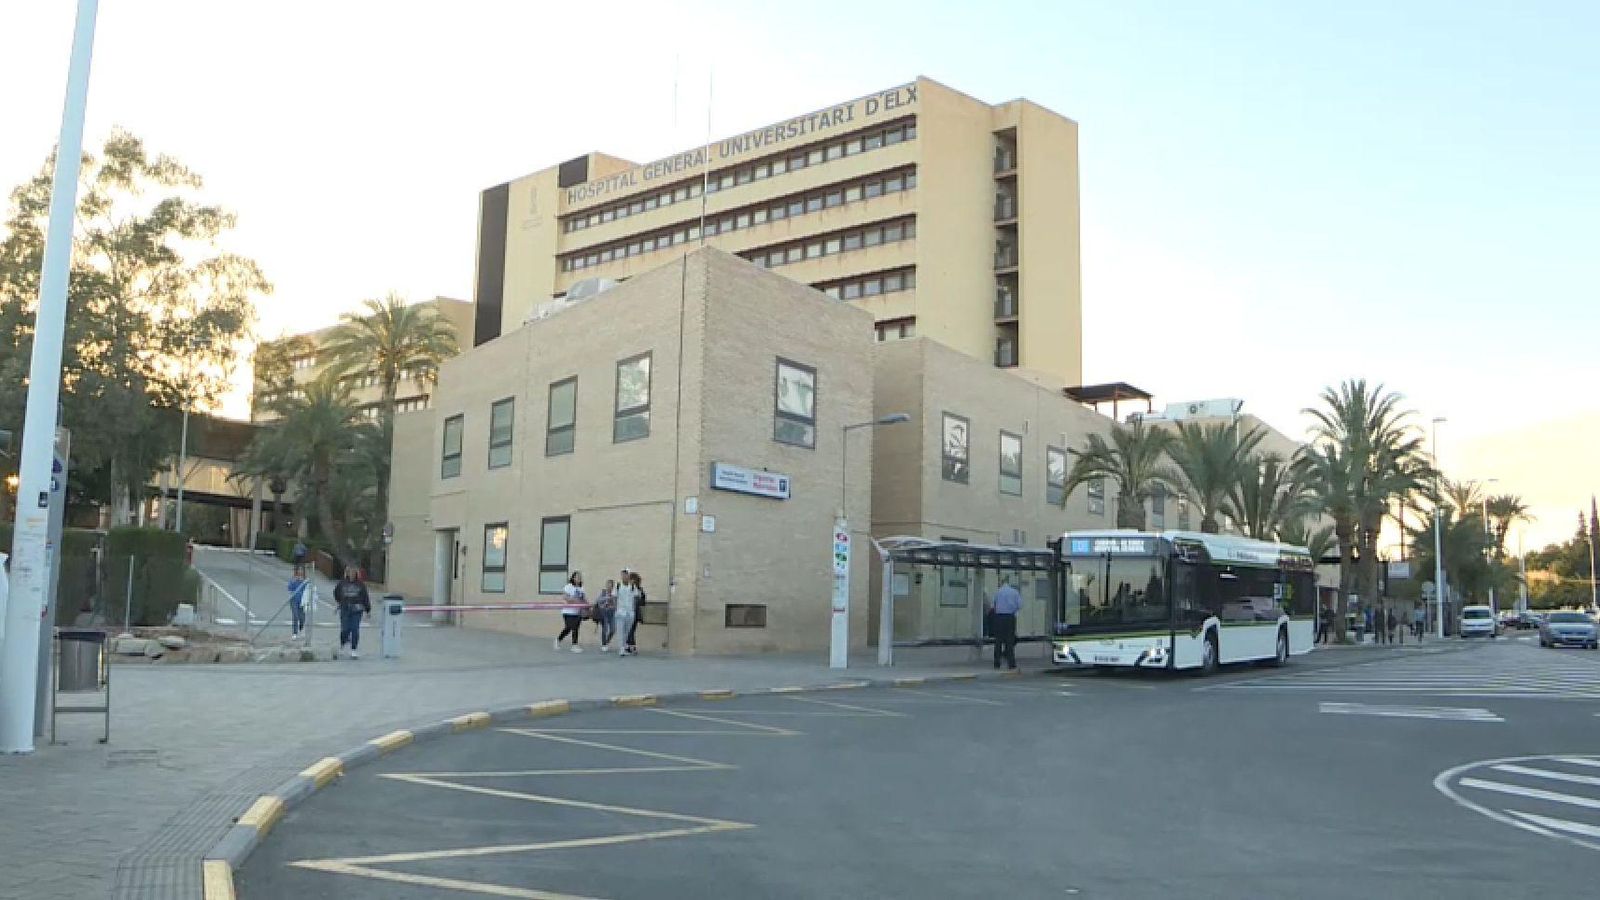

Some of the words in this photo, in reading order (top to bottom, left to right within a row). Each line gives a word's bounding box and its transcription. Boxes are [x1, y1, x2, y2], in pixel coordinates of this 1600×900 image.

[568, 174, 638, 204] HOSPITAL
[644, 148, 713, 180] GENERAL
[720, 105, 855, 157] UNIVERSITARI
[865, 86, 917, 116] D'ELX
